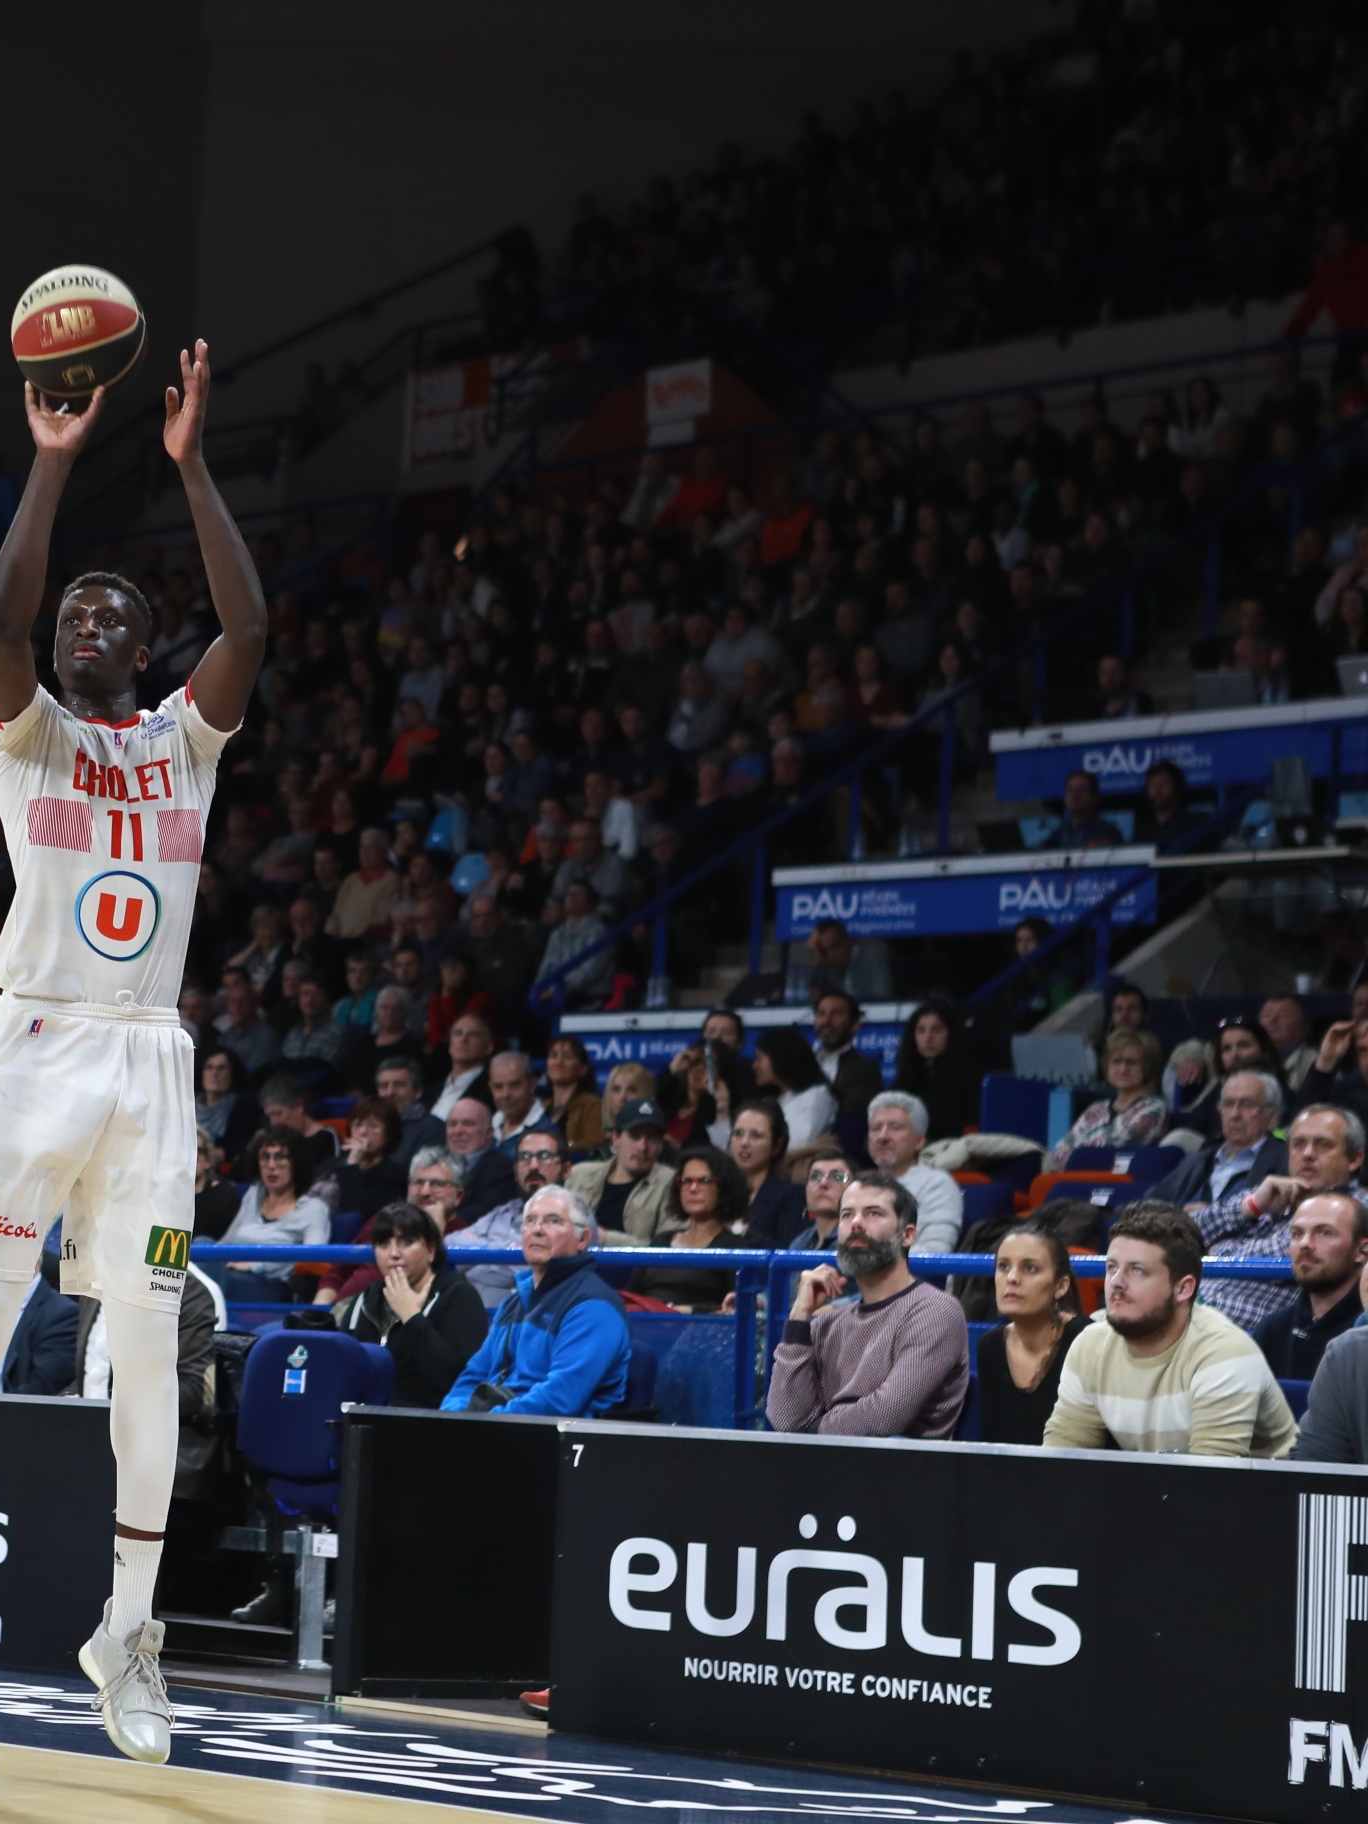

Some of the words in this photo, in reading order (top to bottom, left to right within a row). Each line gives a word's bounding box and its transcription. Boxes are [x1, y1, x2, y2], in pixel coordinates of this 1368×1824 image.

[21, 275, 110, 314] SPALDING
[1083, 745, 1152, 777] PAU
[107, 809, 143, 862] 11
[792, 888, 860, 921] PAU
[999, 876, 1073, 911] PAU
[96, 893, 143, 941] U
[149, 1282, 182, 1295] SPALDING
[152, 1268, 185, 1280] CHOLET
[572, 1444, 585, 1467] 7
[684, 1657, 779, 1687] NOURRIR
[784, 1667, 856, 1695] VOTRE
[861, 1675, 993, 1709] CONFIANCE
